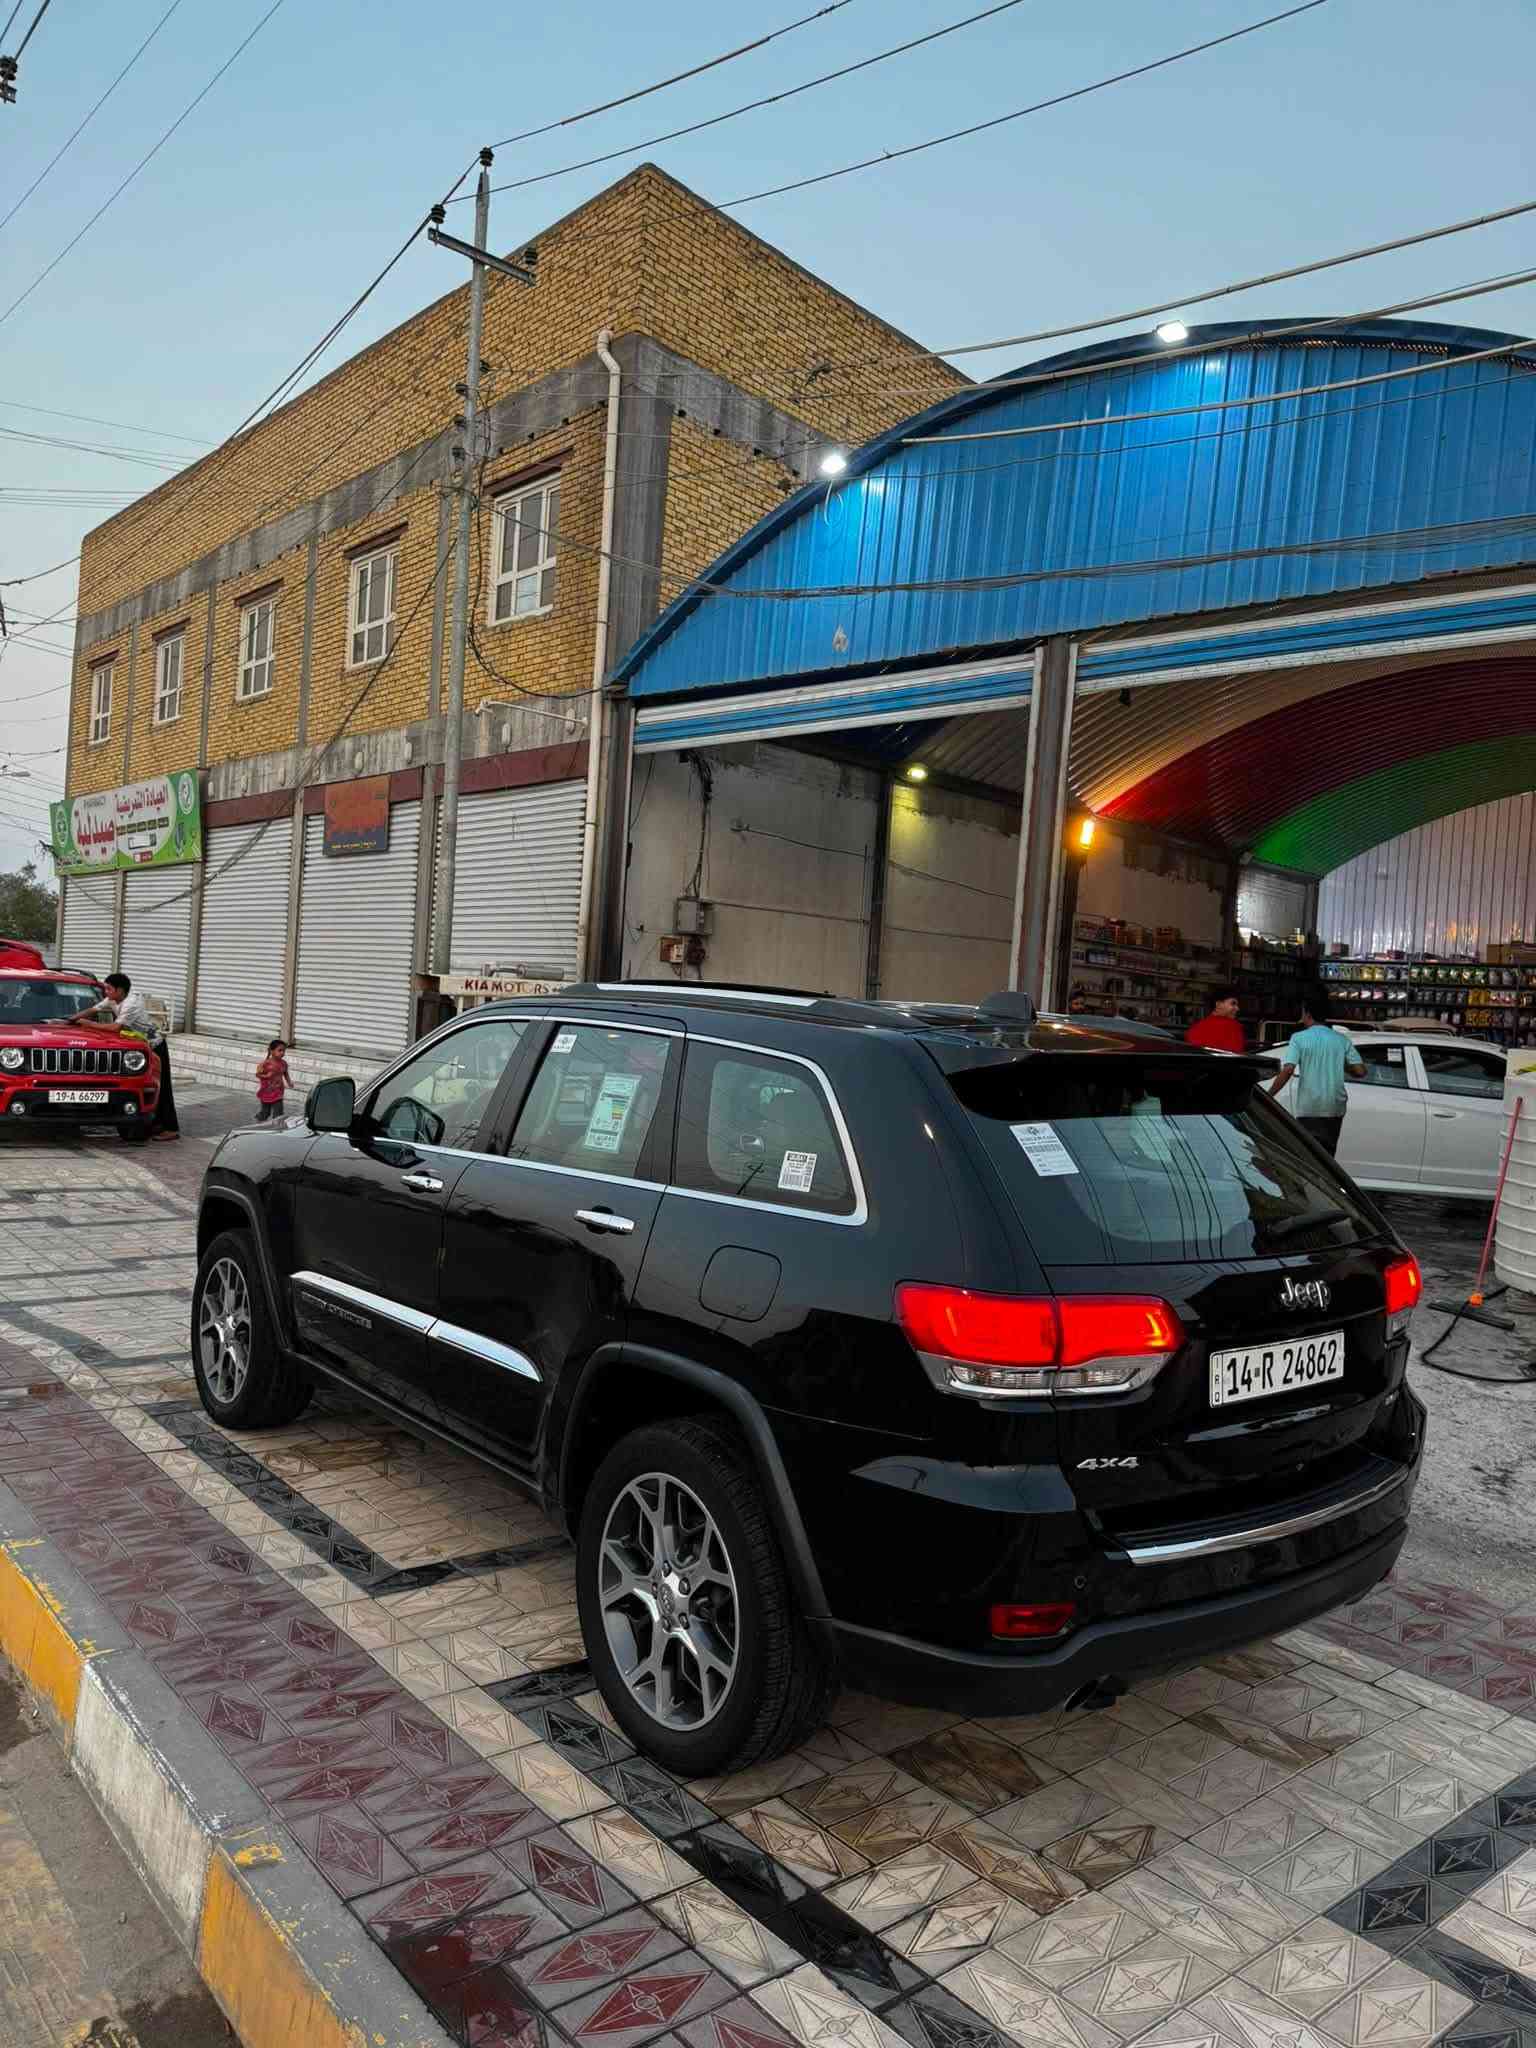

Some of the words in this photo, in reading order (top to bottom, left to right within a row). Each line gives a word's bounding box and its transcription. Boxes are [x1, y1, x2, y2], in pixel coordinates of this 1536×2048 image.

[464, 979, 489, 992] KIA
[491, 981, 550, 994] MOTORS
[1280, 1276, 1330, 1312] Jeep
[1282, 1339, 1338, 1385] 24862
